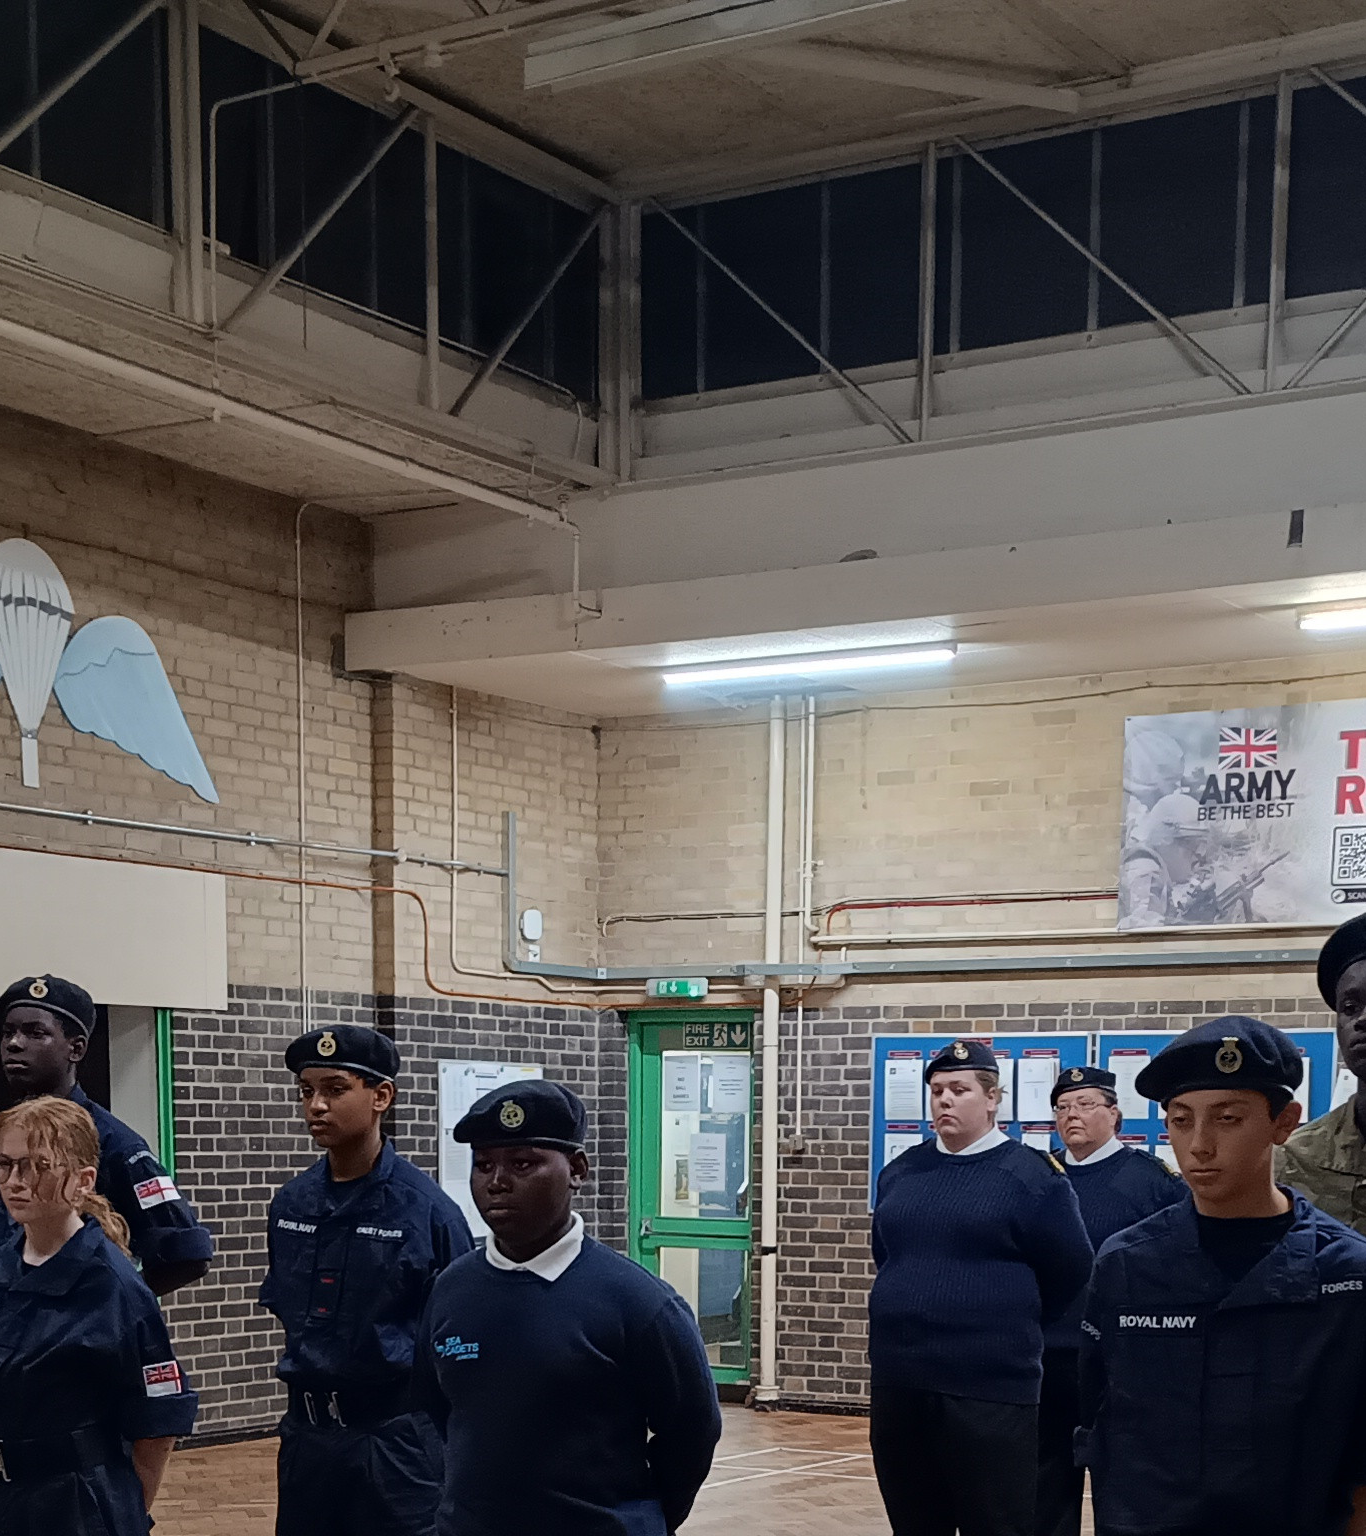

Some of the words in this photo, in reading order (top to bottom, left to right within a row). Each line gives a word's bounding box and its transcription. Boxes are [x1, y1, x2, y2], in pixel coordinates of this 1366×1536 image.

[1199, 768, 1296, 805] ARMY
[1197, 803, 1217, 821] BE
[1220, 803, 1252, 820] THE
[1255, 802, 1295, 818] BEST
[686, 1024, 710, 1033] FIRE
[686, 1036, 709, 1046] EXIT
[1321, 1280, 1363, 1294] FORCES
[1119, 1315, 1161, 1328] ROYAL
[1162, 1316, 1196, 1328] NAVY
[445, 1336, 461, 1347] SEA
[445, 1342, 479, 1356] CADETS
